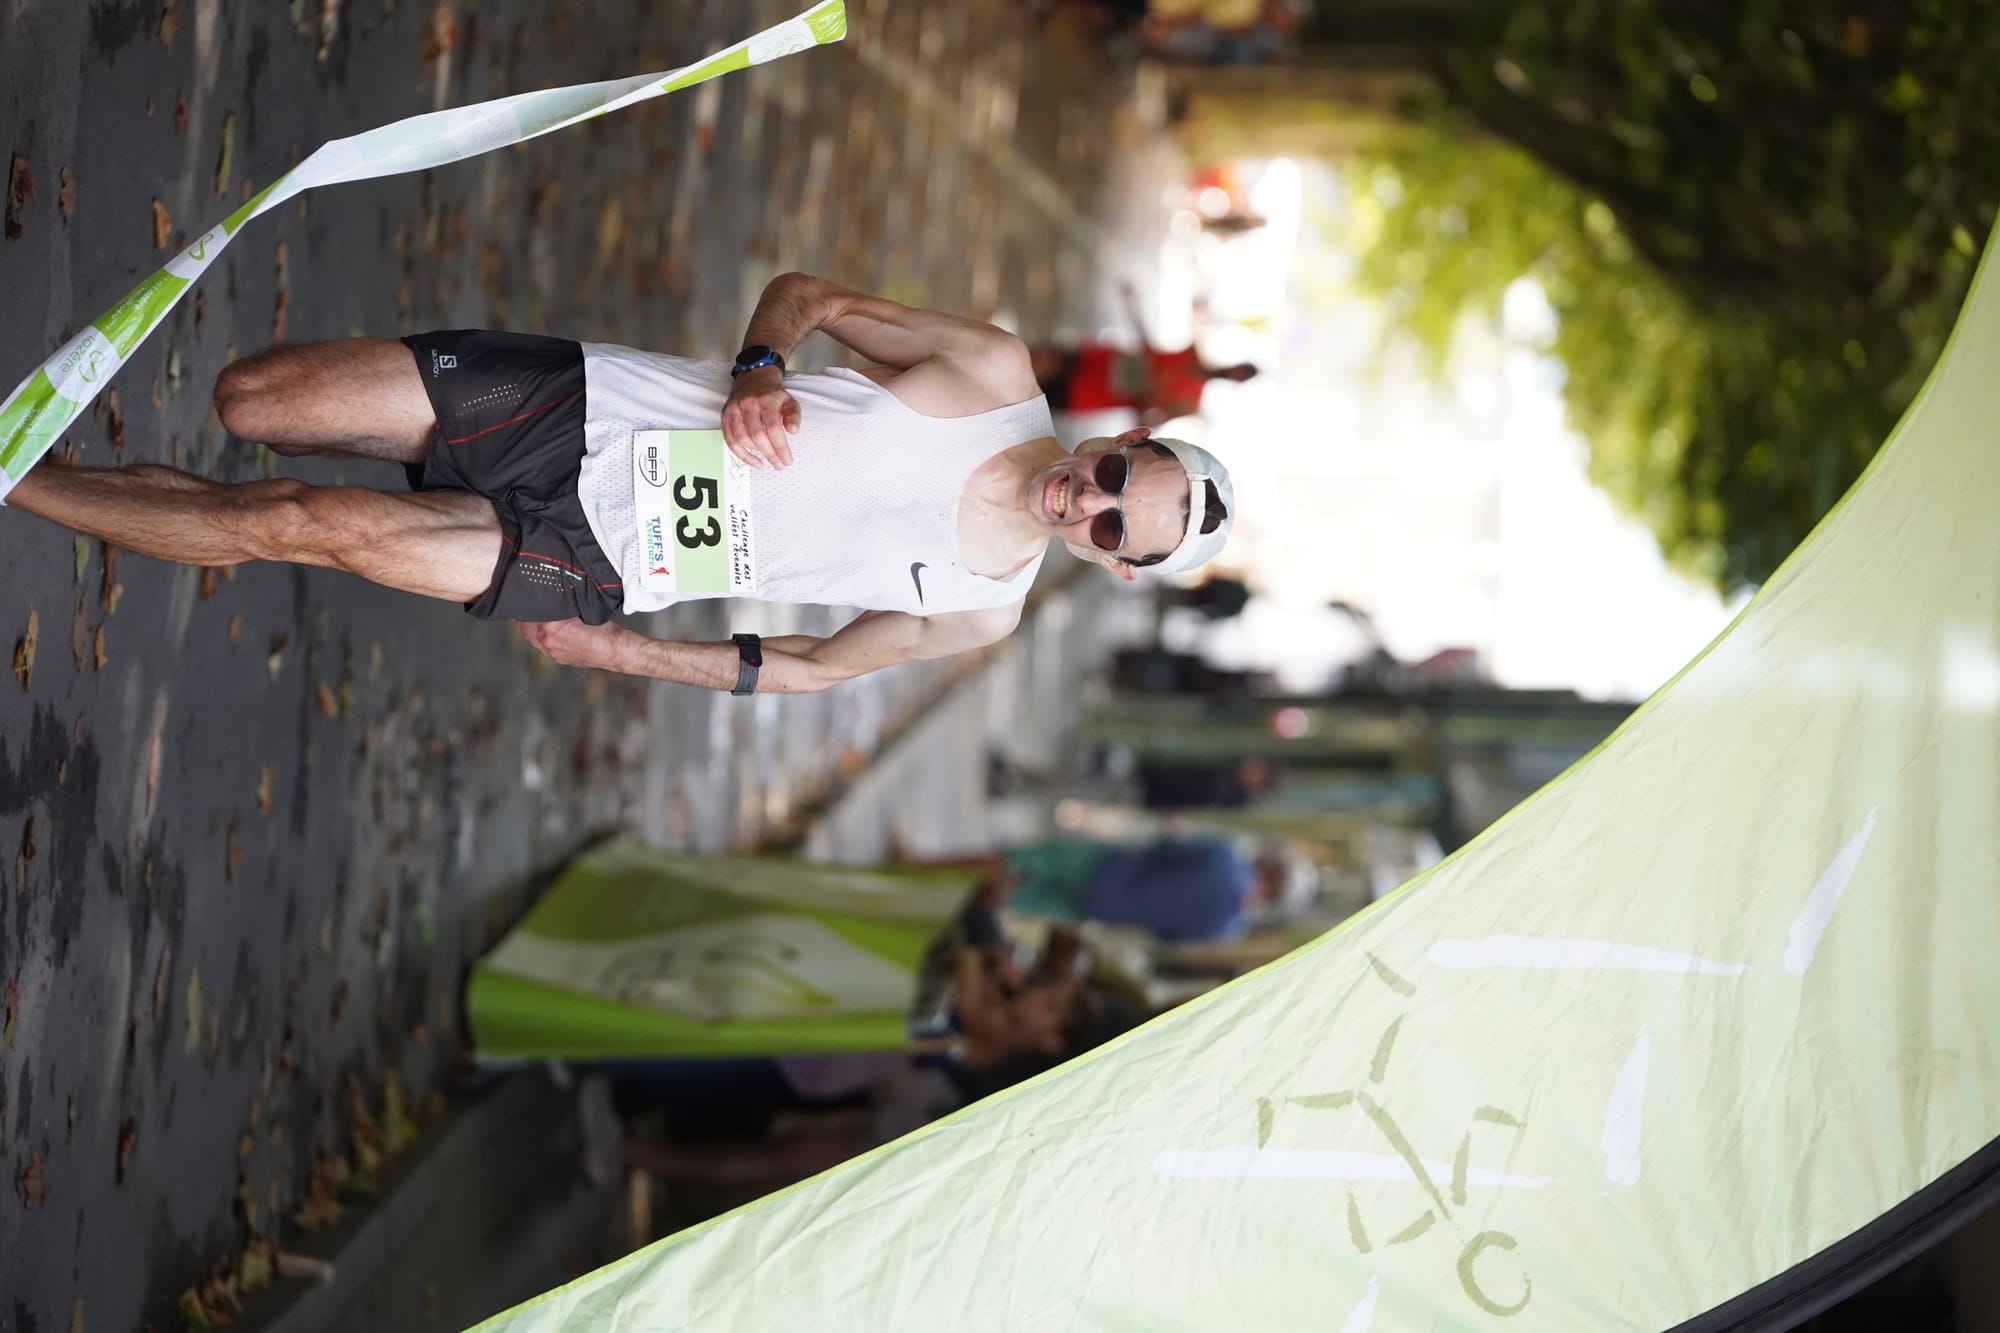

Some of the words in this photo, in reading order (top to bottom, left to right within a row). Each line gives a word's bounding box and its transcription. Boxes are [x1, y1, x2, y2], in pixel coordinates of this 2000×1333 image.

[60, 335, 95, 373] lozère
[648, 446, 657, 481] BFP
[673, 474, 721, 549] 53
[730, 504, 739, 537] vallées
[740, 509, 749, 557] Challenge
[645, 520, 655, 566] Aventure
[652, 516, 663, 561] TUFF'S
[733, 543, 742, 585] cévenoles
